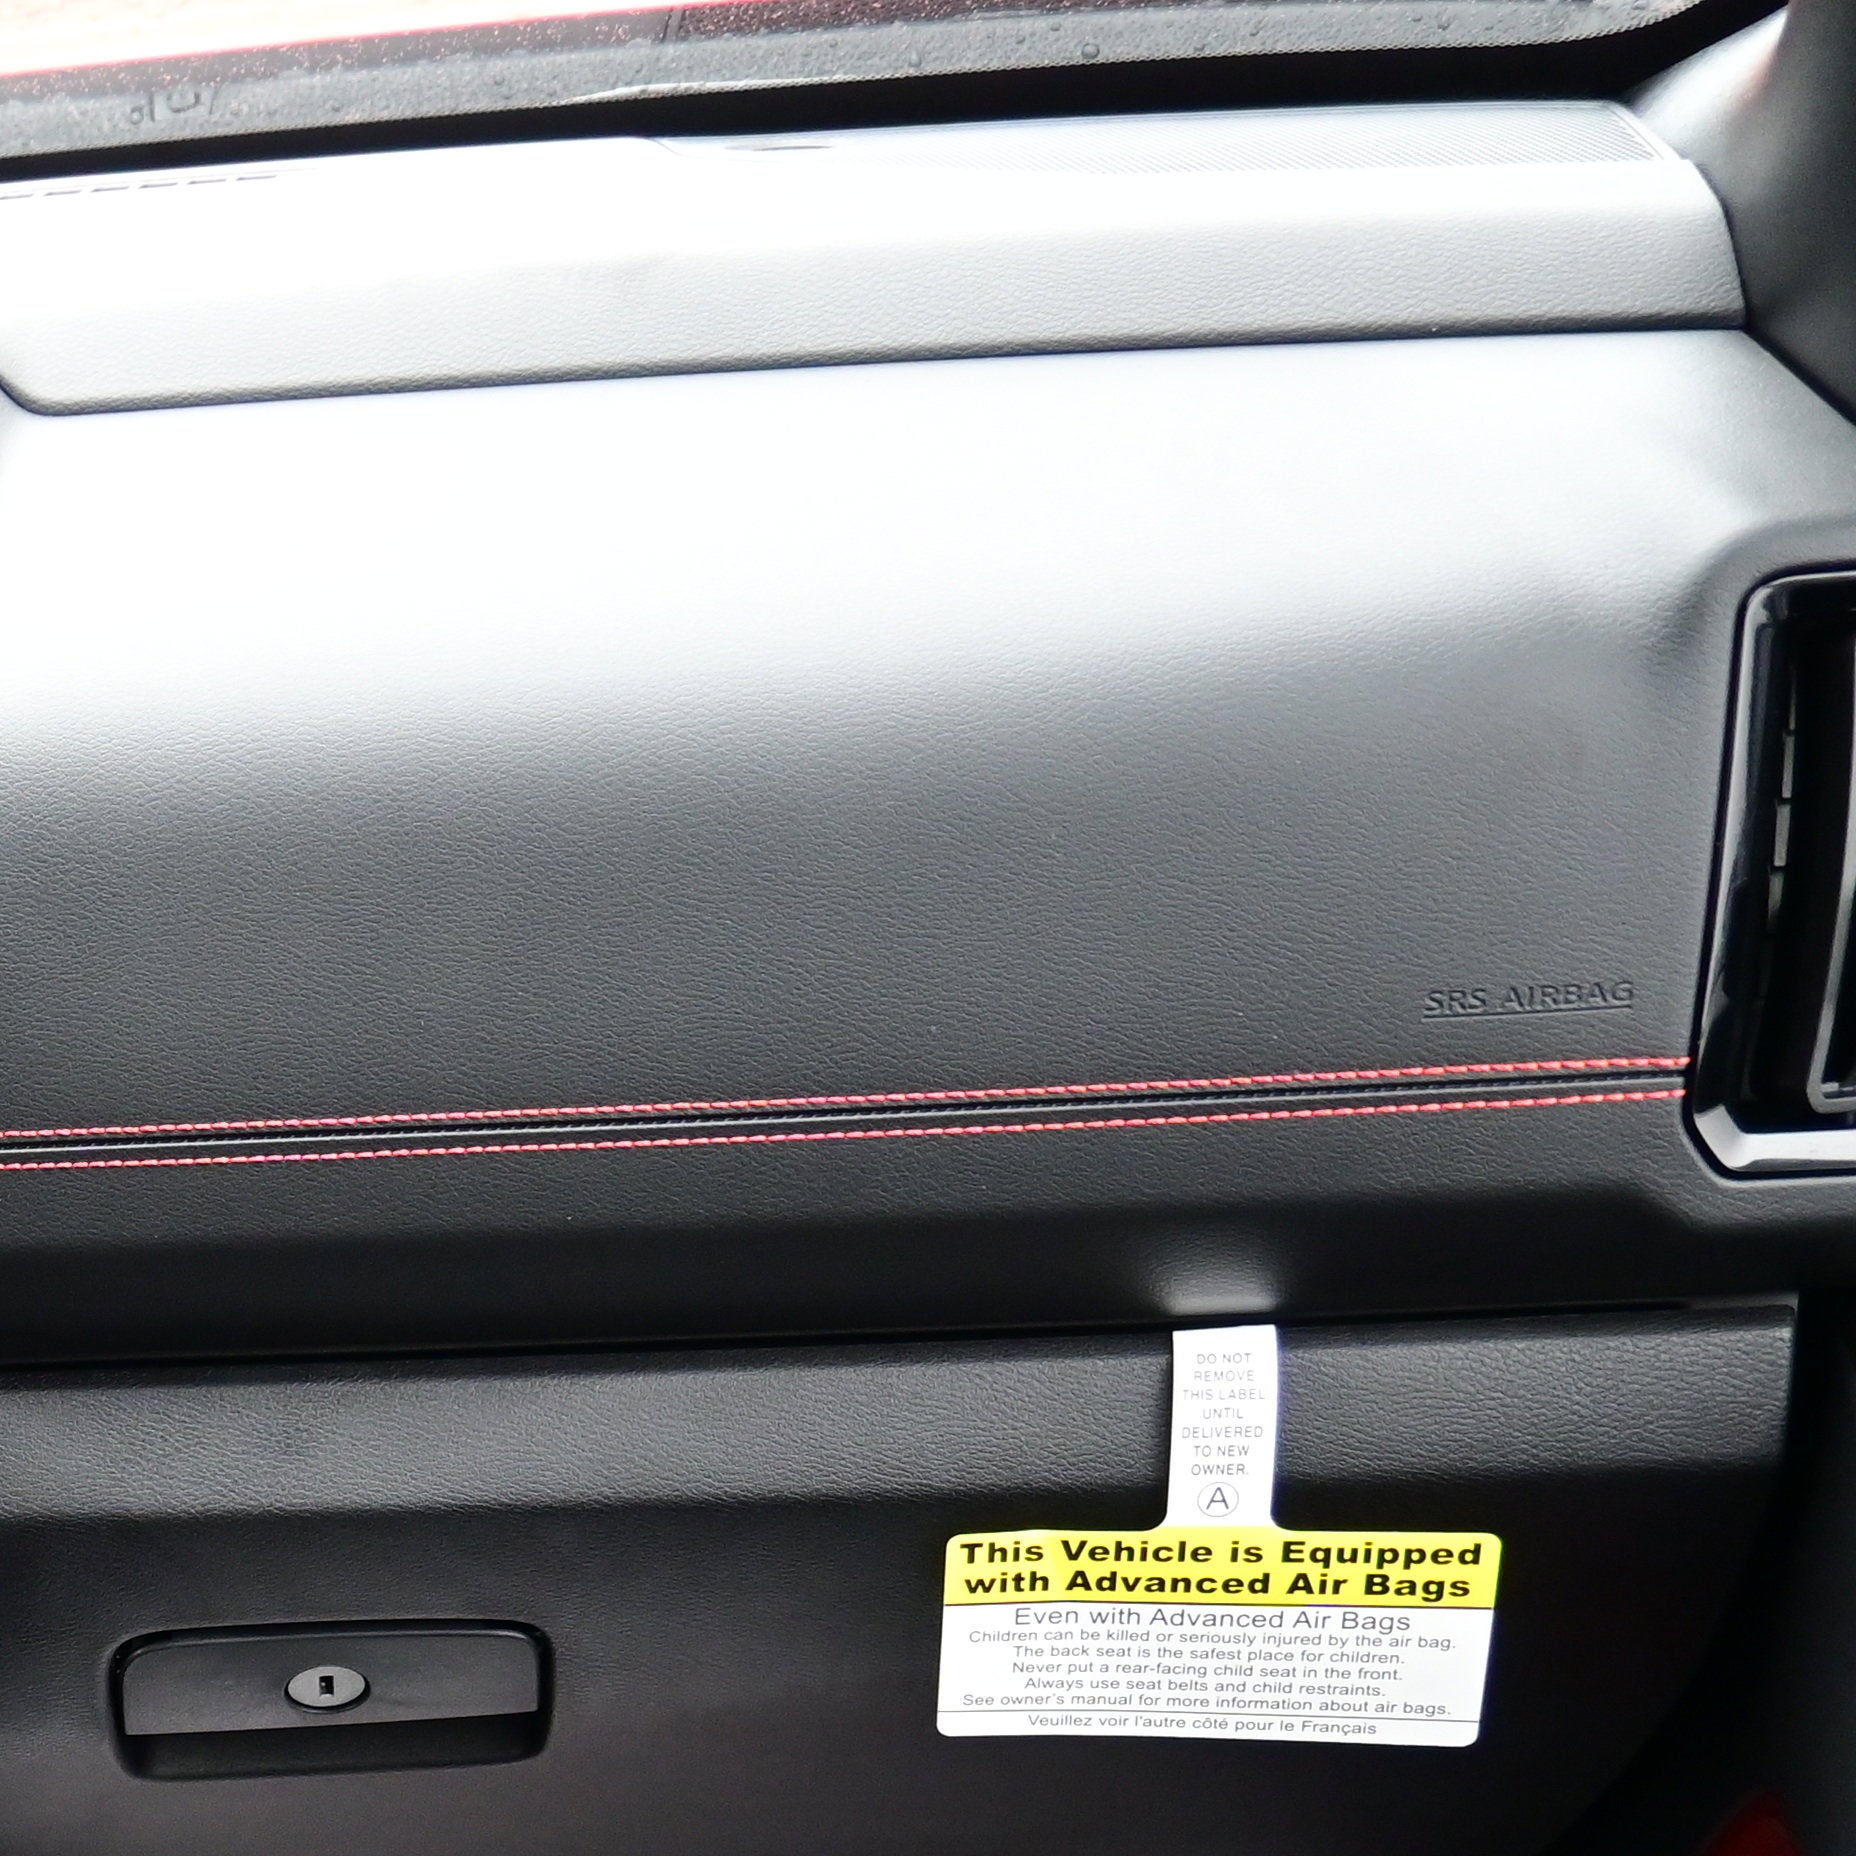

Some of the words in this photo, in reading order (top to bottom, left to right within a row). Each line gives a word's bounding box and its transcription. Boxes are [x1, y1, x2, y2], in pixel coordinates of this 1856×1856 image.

[1425, 988, 1488, 1014] SRS
[1497, 980, 1634, 1011] AIRBAG
[1197, 1354, 1217, 1364] DO
[1223, 1353, 1251, 1364] NOT
[1194, 1370, 1254, 1382] REMOVE
[1183, 1389, 1213, 1400] THIS
[1219, 1389, 1265, 1400] LABEL
[1203, 1408, 1243, 1419] UNTIL
[1182, 1426, 1263, 1438] DELIVERED
[1194, 1446, 1211, 1457] TO
[1217, 1445, 1250, 1456] NEW
[1191, 1464, 1248, 1475] OWNER.
[1206, 1487, 1229, 1509] A
[960, 1541, 1044, 1564] This
[1061, 1540, 1213, 1562] Vehicle
[1230, 1541, 1263, 1563] is
[1281, 1541, 1481, 1569] Equipped
[964, 1571, 1049, 1594] with
[1065, 1570, 1270, 1594] Advanced
[1286, 1573, 1348, 1595] Air
[1364, 1574, 1470, 1602] Bags
[1015, 1608, 1078, 1625] Even
[1090, 1608, 1140, 1625] with
[1149, 1609, 1284, 1628] Advanced
[1293, 1611, 1331, 1629] Air
[1342, 1612, 1410, 1634] Bags
[969, 1631, 1037, 1643] Children
[1044, 1631, 1073, 1640] can
[1081, 1630, 1100, 1640] be
[1107, 1630, 1150, 1641] killed
[1156, 1632, 1173, 1642] or
[1179, 1632, 1256, 1647] seriously
[1263, 1633, 1321, 1647] injured
[1329, 1634, 1349, 1647] by
[1356, 1635, 1382, 1647] the
[1389, 1636, 1411, 1648] air
[1418, 1636, 1456, 1651] bag.
[1013, 1646, 1044, 1657] The
[1051, 1646, 1089, 1657] back
[1096, 1647, 1131, 1657] seat
[1137, 1647, 1150, 1658] is
[1157, 1647, 1183, 1659] the
[1190, 1648, 1242, 1661] safest
[1247, 1650, 1294, 1663] place
[1301, 1651, 1324, 1662] for
[1330, 1651, 1404, 1664] children.
[963, 1694, 994, 1706] See
[1001, 1693, 1064, 1705] owner's
[1071, 1694, 1132, 1706] manual
[1138, 1695, 1160, 1706] for
[1167, 1698, 1209, 1707] more
[1216, 1697, 1312, 1711] information
[1319, 1700, 1368, 1713] about
[1375, 1701, 1397, 1714] air
[1404, 1702, 1451, 1717] bags.
[1028, 1715, 1092, 1727] Veuillez
[1099, 1717, 1129, 1727] voir
[1135, 1715, 1186, 1728] l'autre
[1193, 1717, 1228, 1729] côté
[1235, 1721, 1272, 1732] pour
[1280, 1720, 1295, 1732] le
[1302, 1720, 1377, 1736] Français
